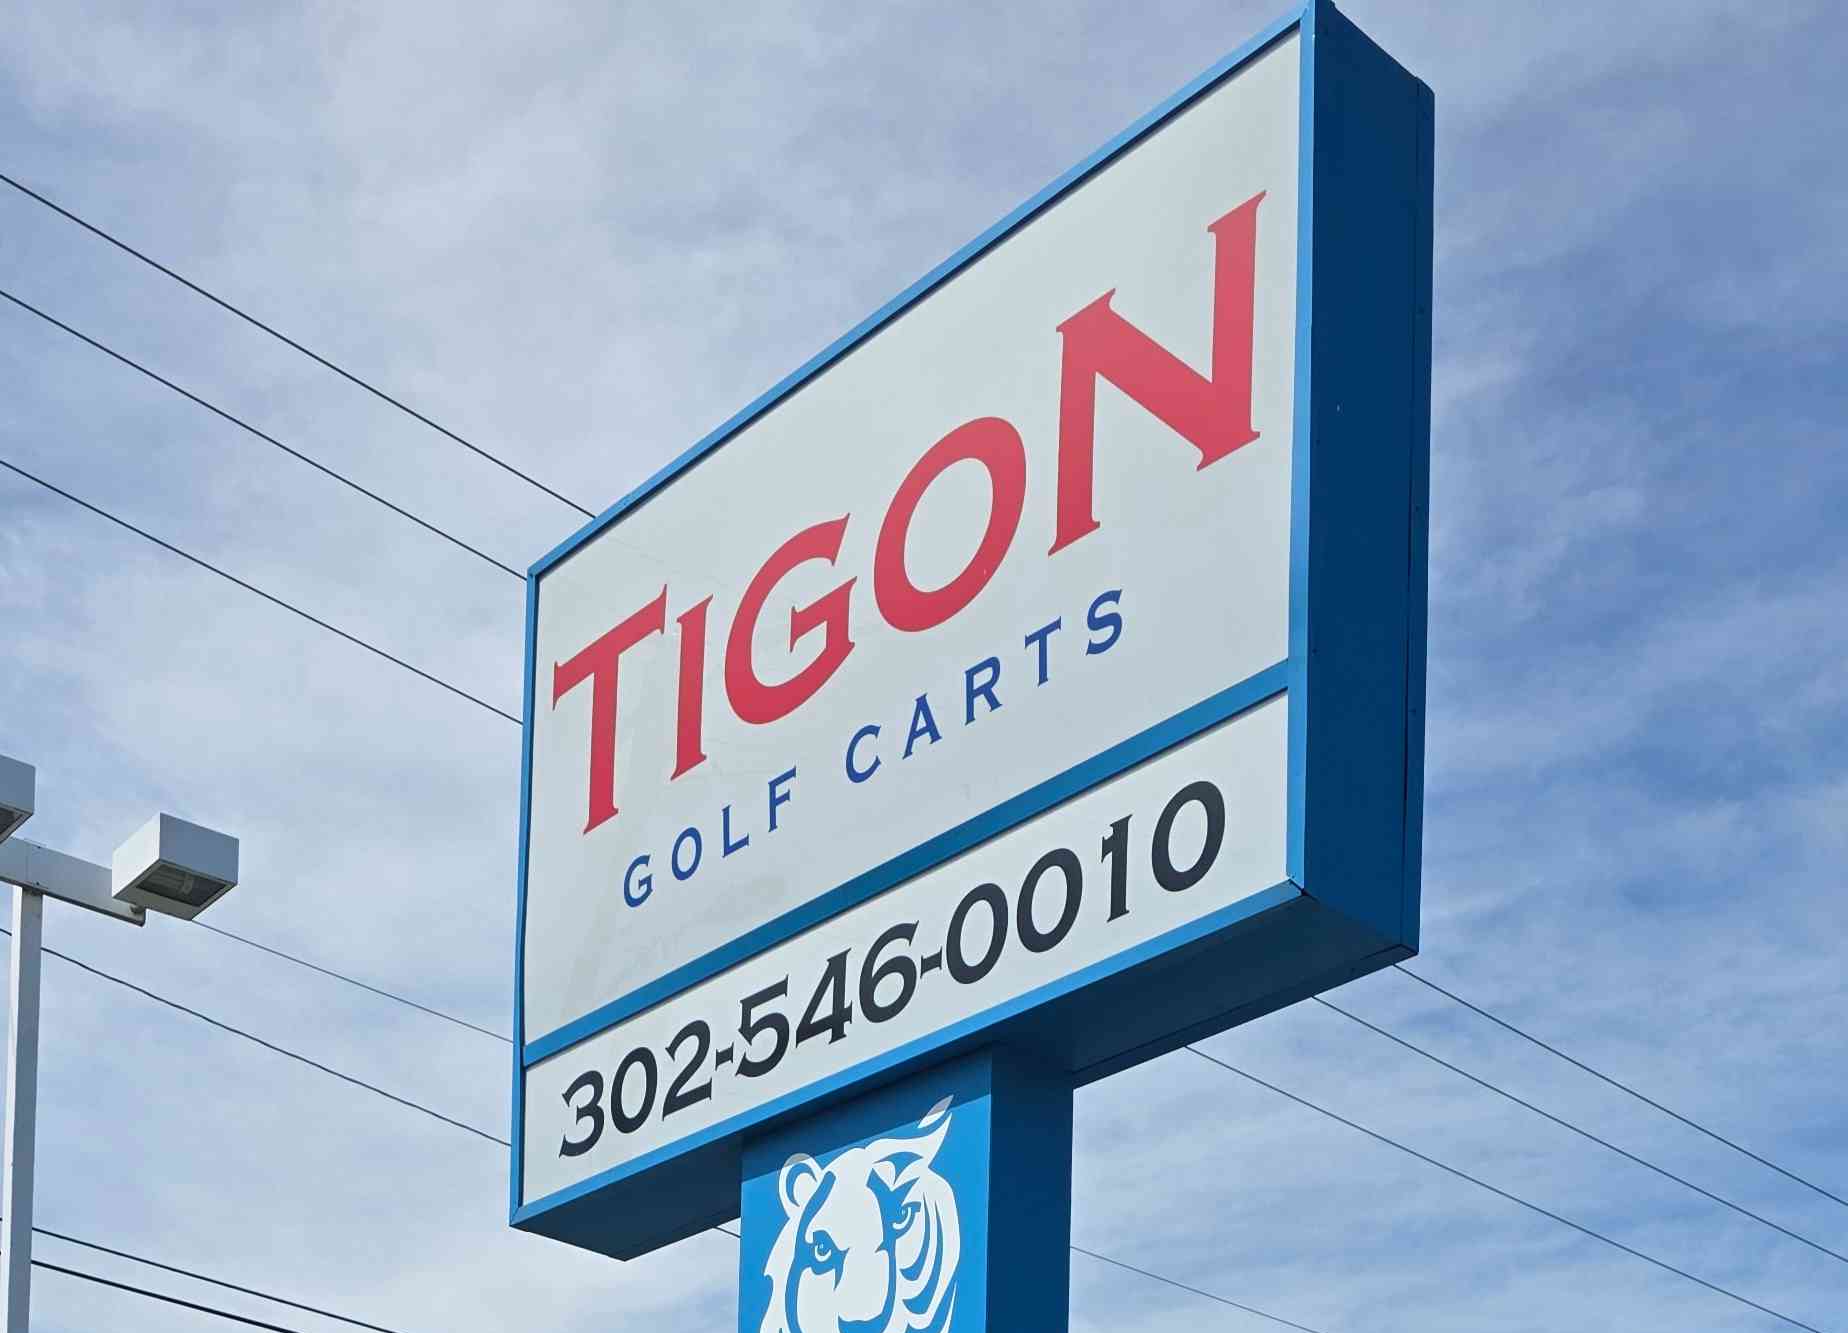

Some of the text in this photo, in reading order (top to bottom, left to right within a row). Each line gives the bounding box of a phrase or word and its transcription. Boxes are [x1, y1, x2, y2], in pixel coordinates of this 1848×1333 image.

[553, 190, 1266, 834] TIGON
[623, 589, 1123, 908] GOLF CARTS
[558, 780, 1227, 1158] 302-546-0010
